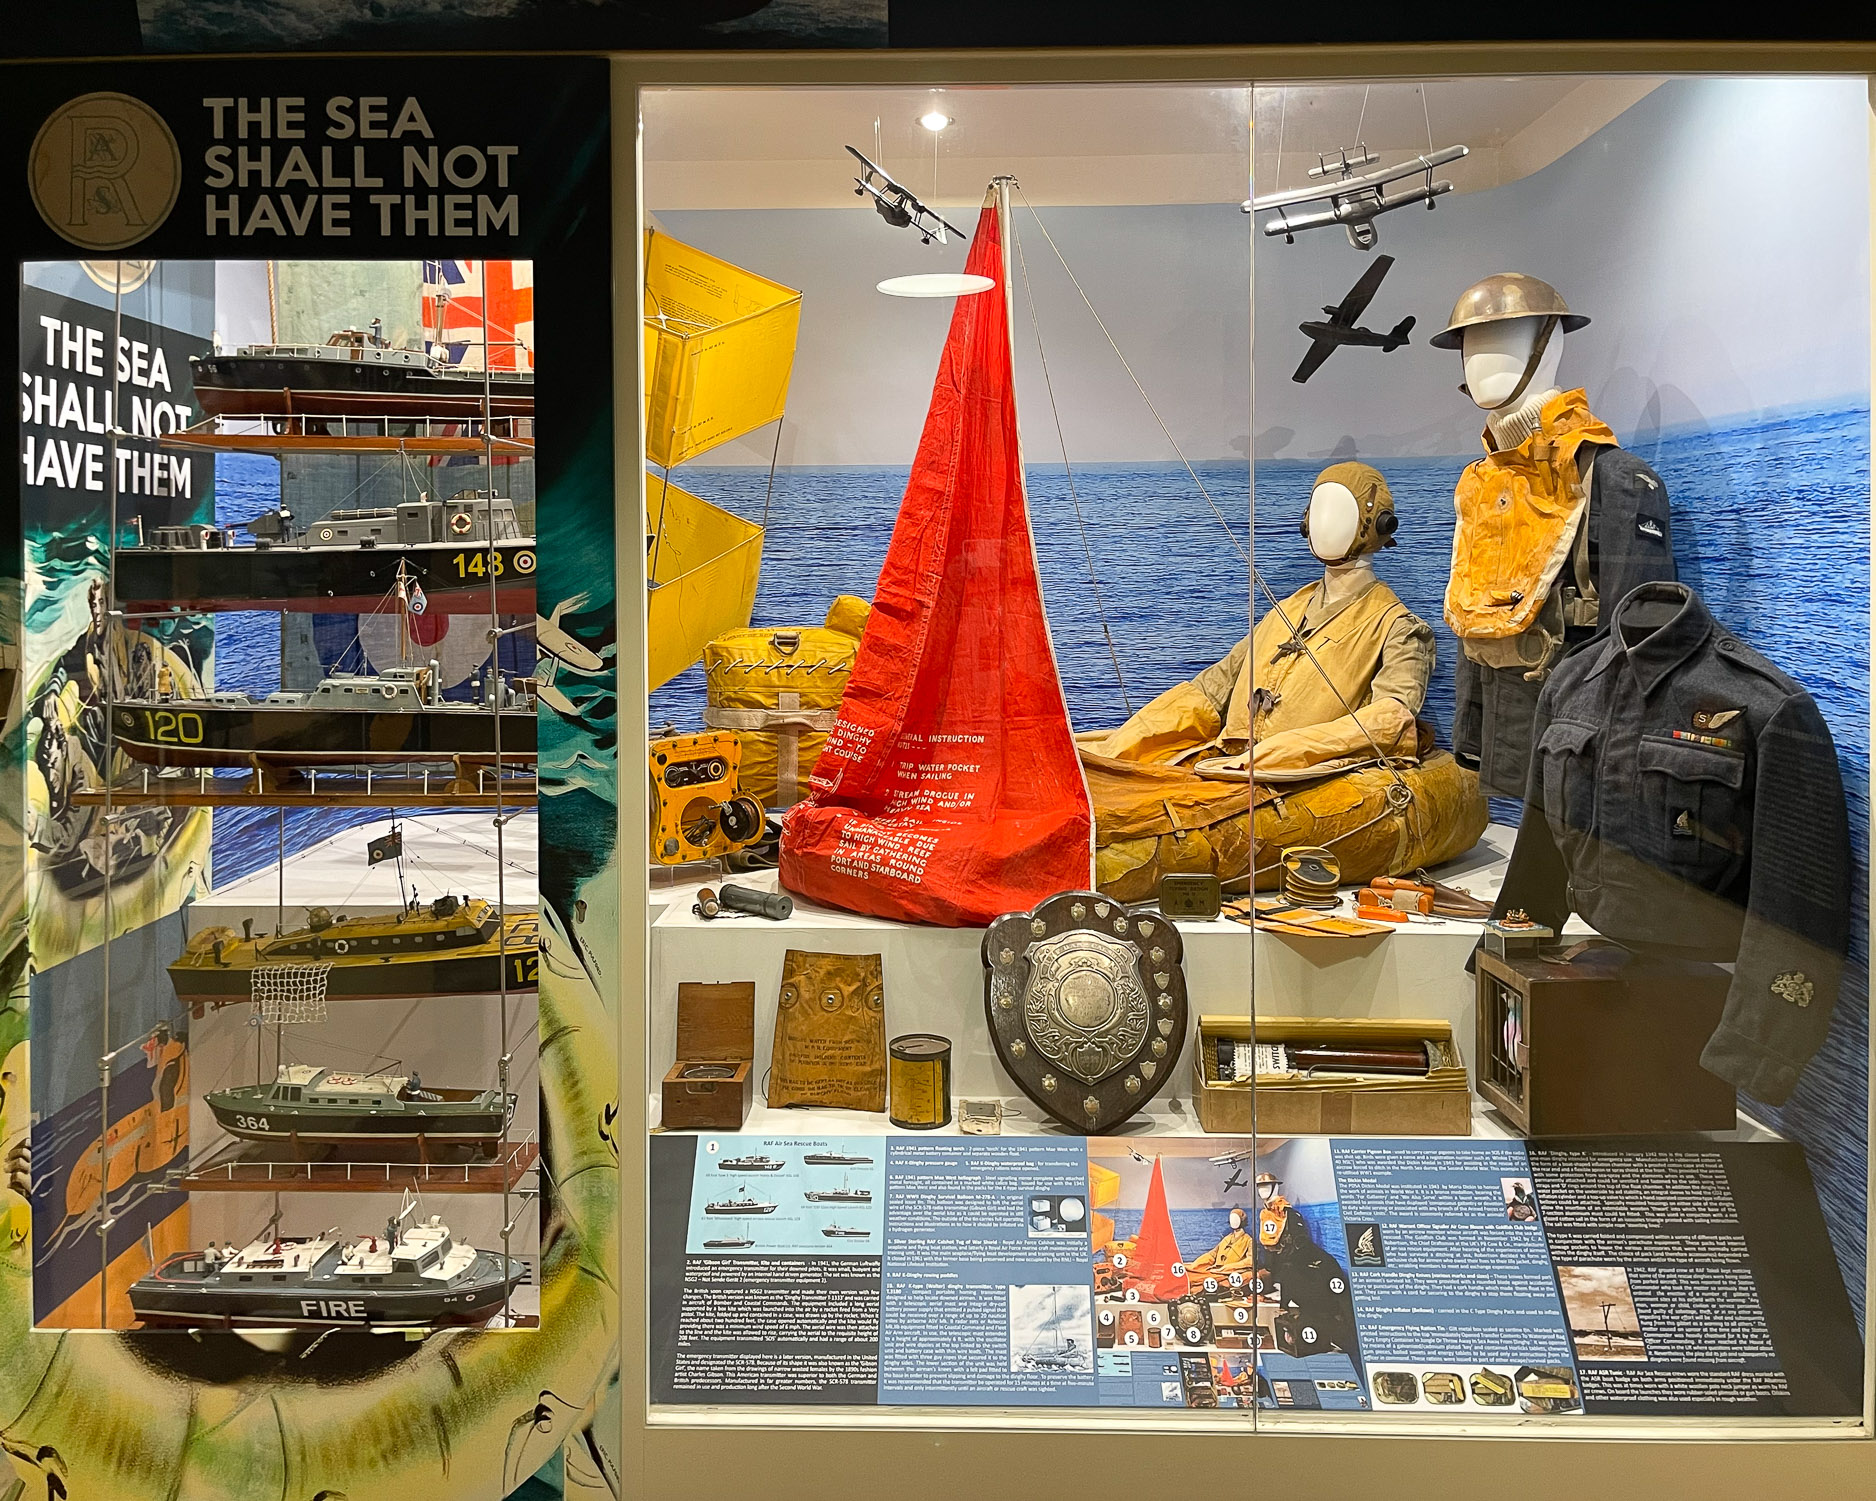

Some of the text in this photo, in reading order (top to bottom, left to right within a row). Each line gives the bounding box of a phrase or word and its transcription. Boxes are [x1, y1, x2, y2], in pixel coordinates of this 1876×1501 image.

[202, 95, 435, 139] THE SEA
[204, 145, 519, 188] SHALL NOT
[206, 194, 519, 237] HAVE THEM
[40, 315, 172, 393] THE SEA
[132, 395, 192, 441] NOT
[115, 448, 192, 499] THEM
[452, 551, 504, 578] 148
[1698, 714, 1707, 723] S
[144, 711, 203, 744] 120
[837, 729, 871, 745] DINGHY
[929, 735, 985, 743] INSTRUCTION
[856, 744, 867, 754] TO
[918, 764, 944, 772] WATER
[947, 764, 980, 773] POCKET
[897, 771, 918, 780] WHEN
[924, 789, 959, 800] DROGUE
[963, 792, 975, 800] IN
[911, 797, 934, 805] WIND
[937, 800, 972, 809] AND/OR
[896, 832, 939, 844] BECOMES
[841, 830, 851, 839] TO
[854, 833, 876, 843] HIGH
[907, 846, 932, 858] REEF
[916, 841, 936, 851] DUE
[839, 840, 927, 867] SAIL BY GATHERING
[850, 851, 882, 862] AREAS
[889, 859, 924, 875] ROUND
[830, 855, 921, 884] PORT AND STARBOARD
[830, 864, 869, 880] CORNERS
[235, 1114, 270, 1131] 364
[1265, 1223, 1276, 1232] 17
[1117, 1256, 1123, 1265] 2
[1173, 1265, 1184, 1275] 16
[1205, 1280, 1216, 1290] 15
[1231, 1276, 1241, 1284] 14
[1332, 1281, 1343, 1290] 12
[1130, 1291, 1136, 1301] 3
[300, 1300, 368, 1318] FIRE
[1103, 1313, 1110, 1322] 4
[1151, 1313, 1157, 1322] 6
[1238, 1311, 1244, 1320] 9
[1165, 1327, 1171, 1336] 7
[1190, 1330, 1197, 1339] 8
[1304, 1331, 1315, 1340] 11
[1129, 1334, 1135, 1344] 5
